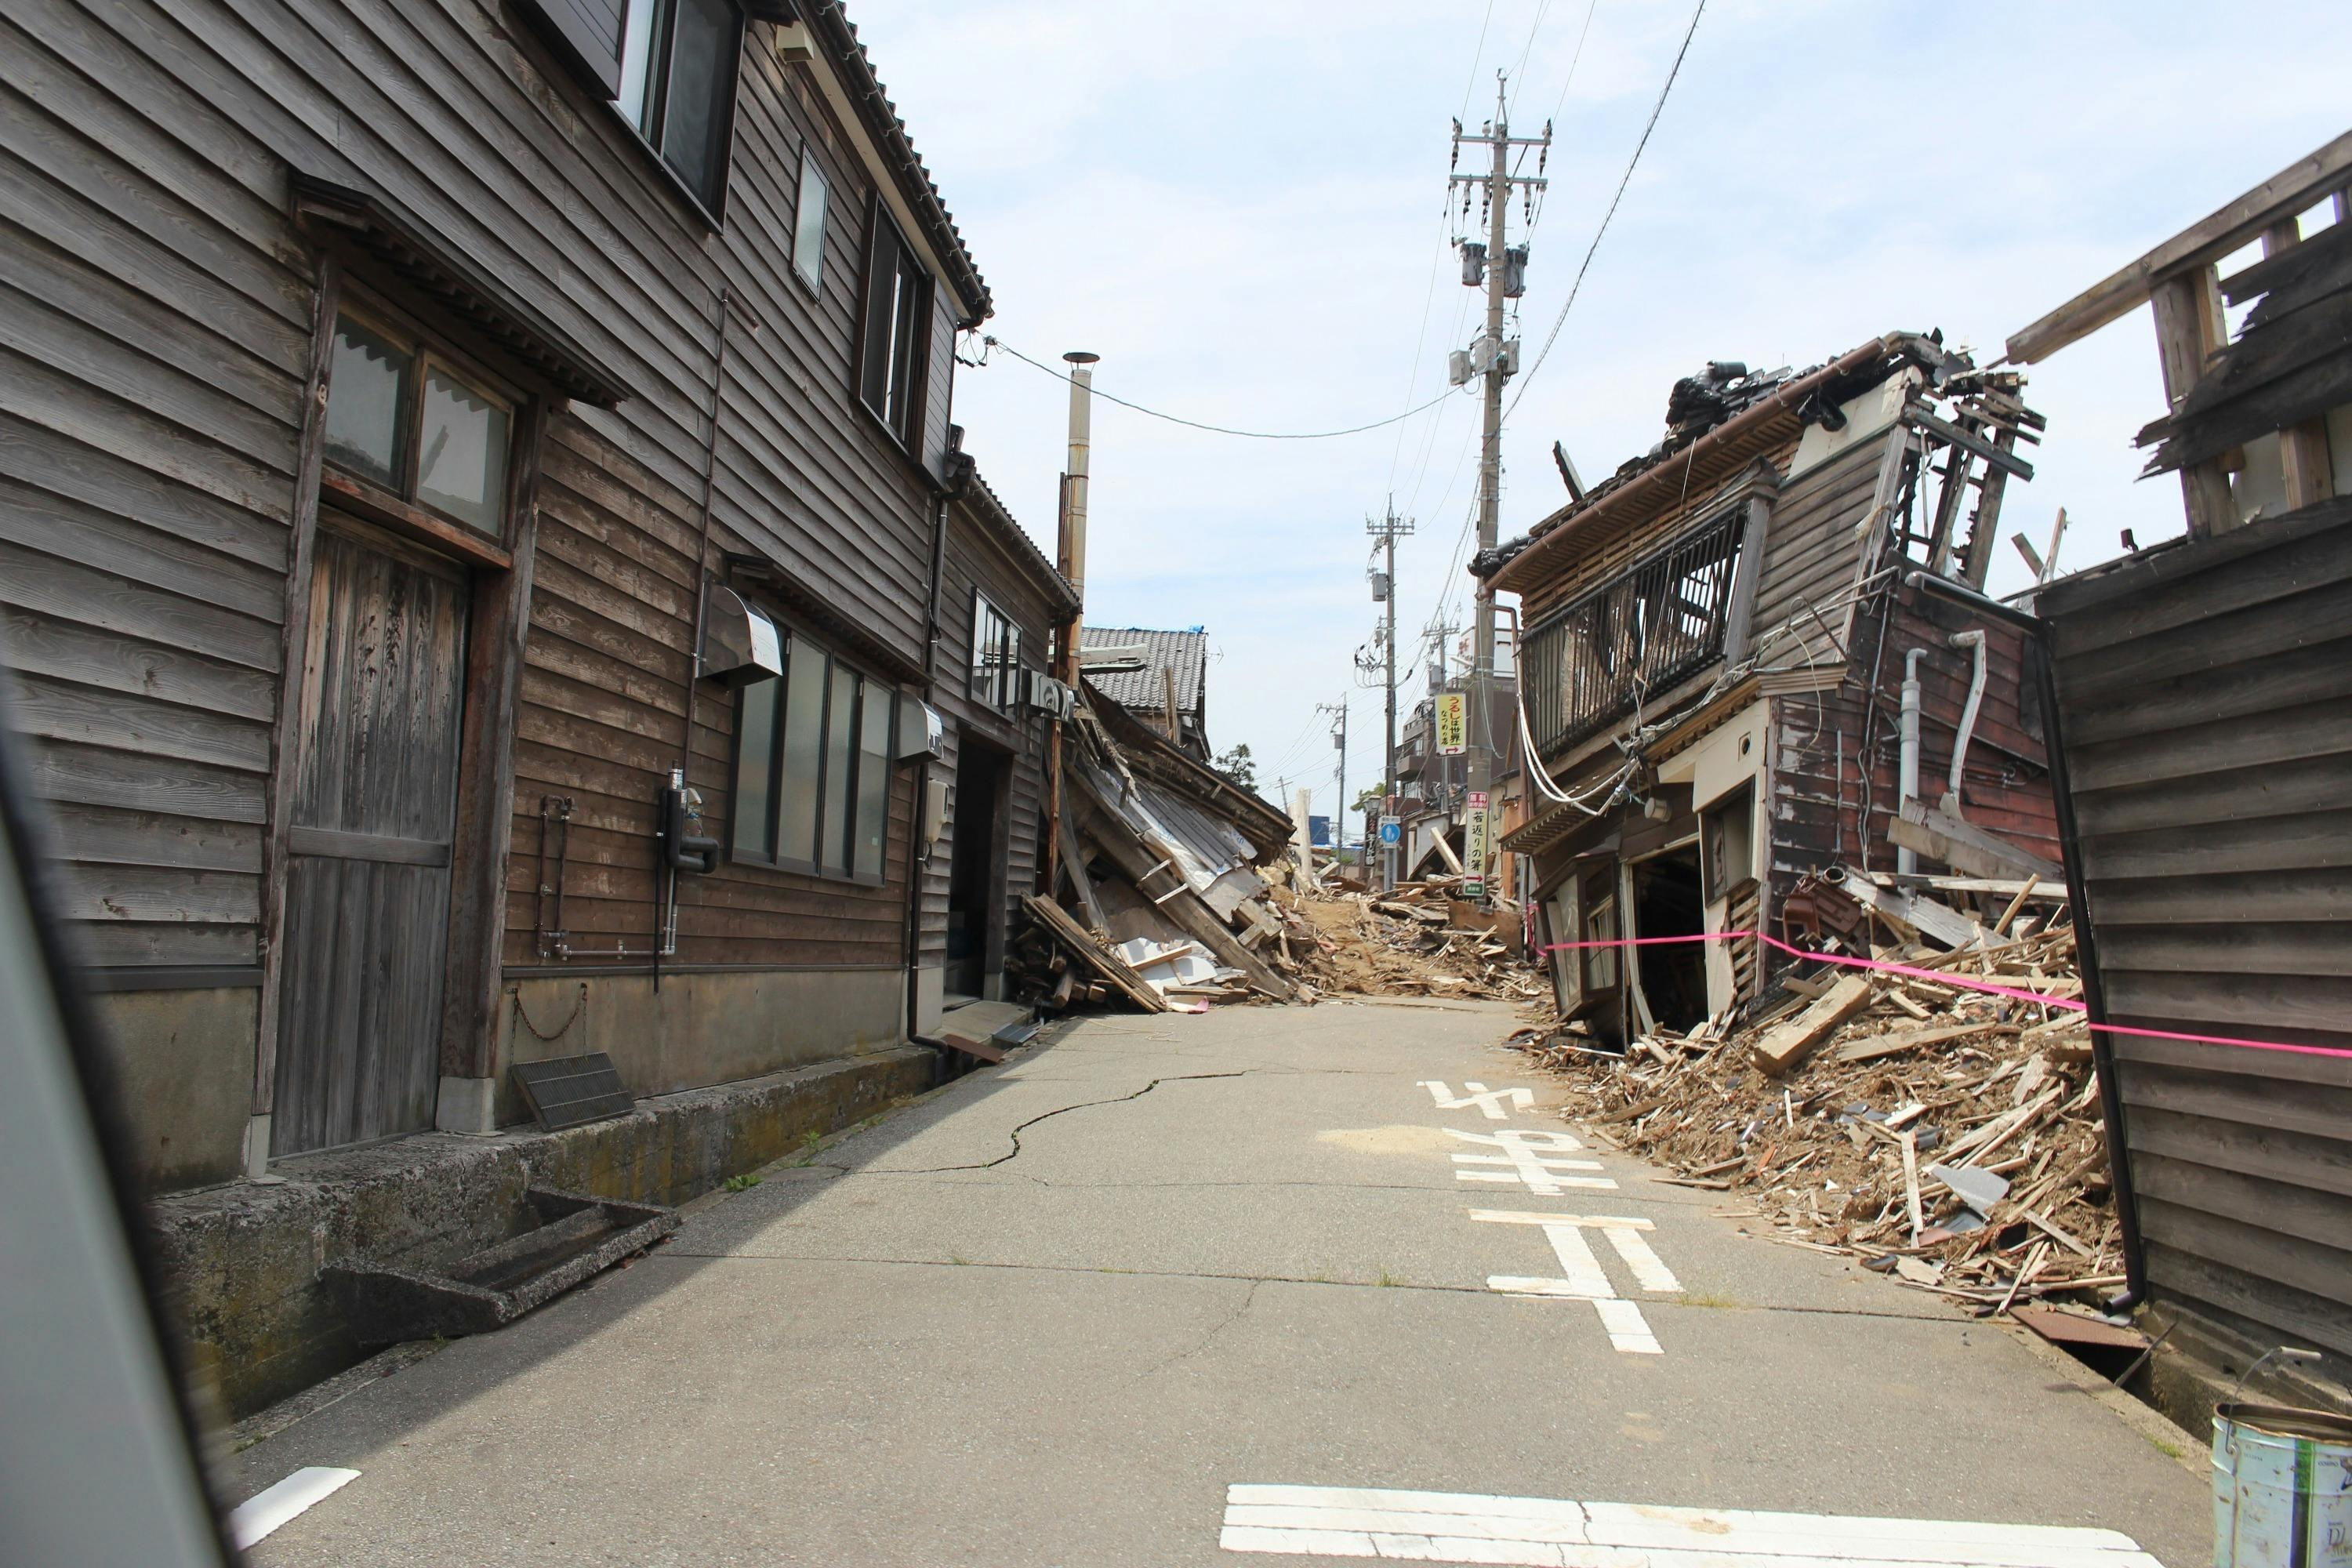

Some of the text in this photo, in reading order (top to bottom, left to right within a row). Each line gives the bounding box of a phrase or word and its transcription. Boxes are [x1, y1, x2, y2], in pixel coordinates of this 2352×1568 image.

[1449, 696, 1461, 746] うるしは世界一
[1472, 811, 1483, 871] 若返りの箸
[1416, 1080, 1686, 1355] 止まれ
